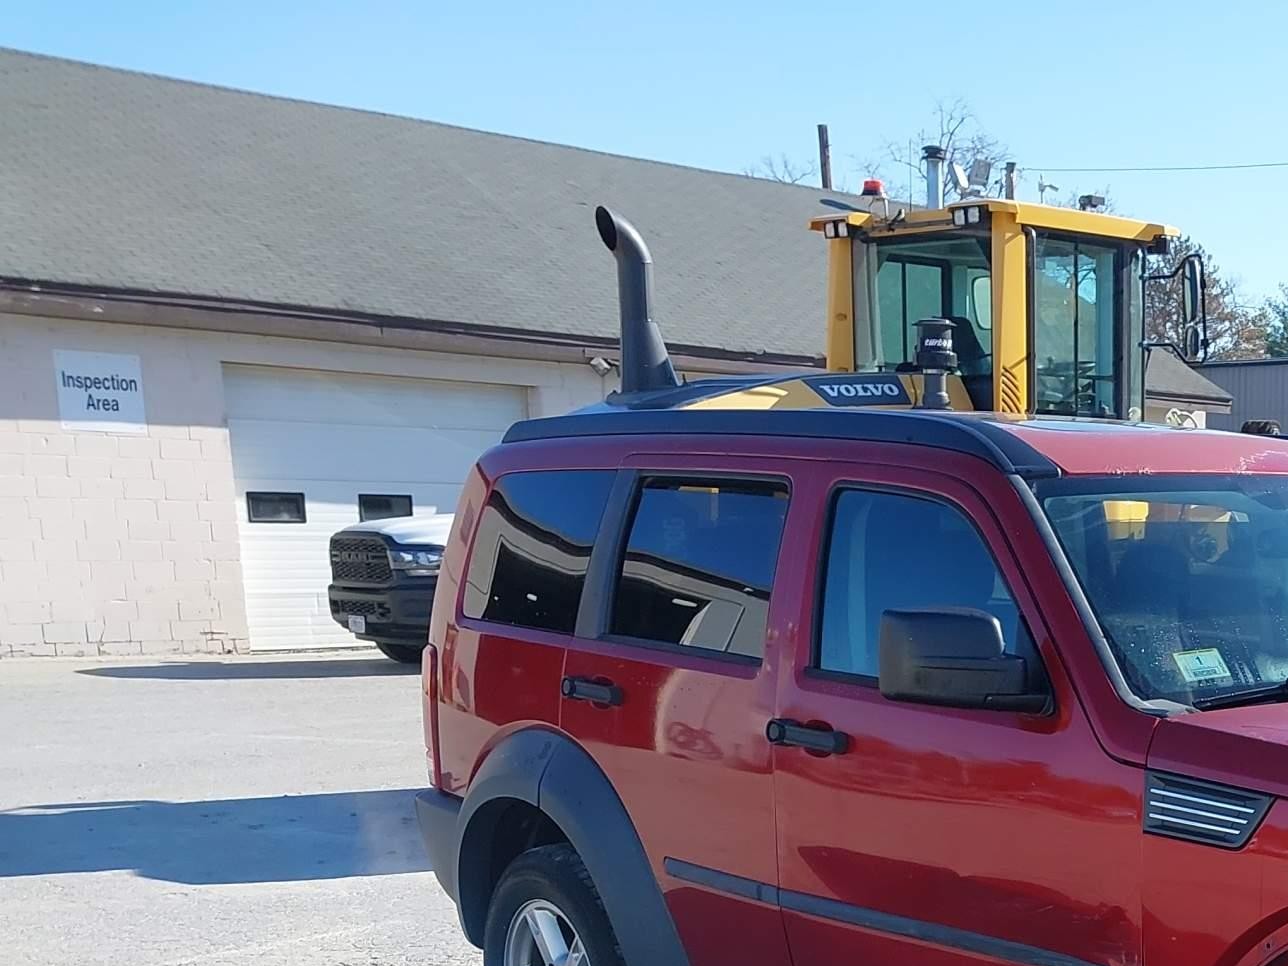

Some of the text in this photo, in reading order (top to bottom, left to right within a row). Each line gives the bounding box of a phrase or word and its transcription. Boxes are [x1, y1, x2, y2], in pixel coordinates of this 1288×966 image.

[61, 370, 138, 393] Inspection
[820, 383, 899, 397] VOLVO
[86, 393, 120, 412] Area
[1195, 655, 1204, 666] 1
